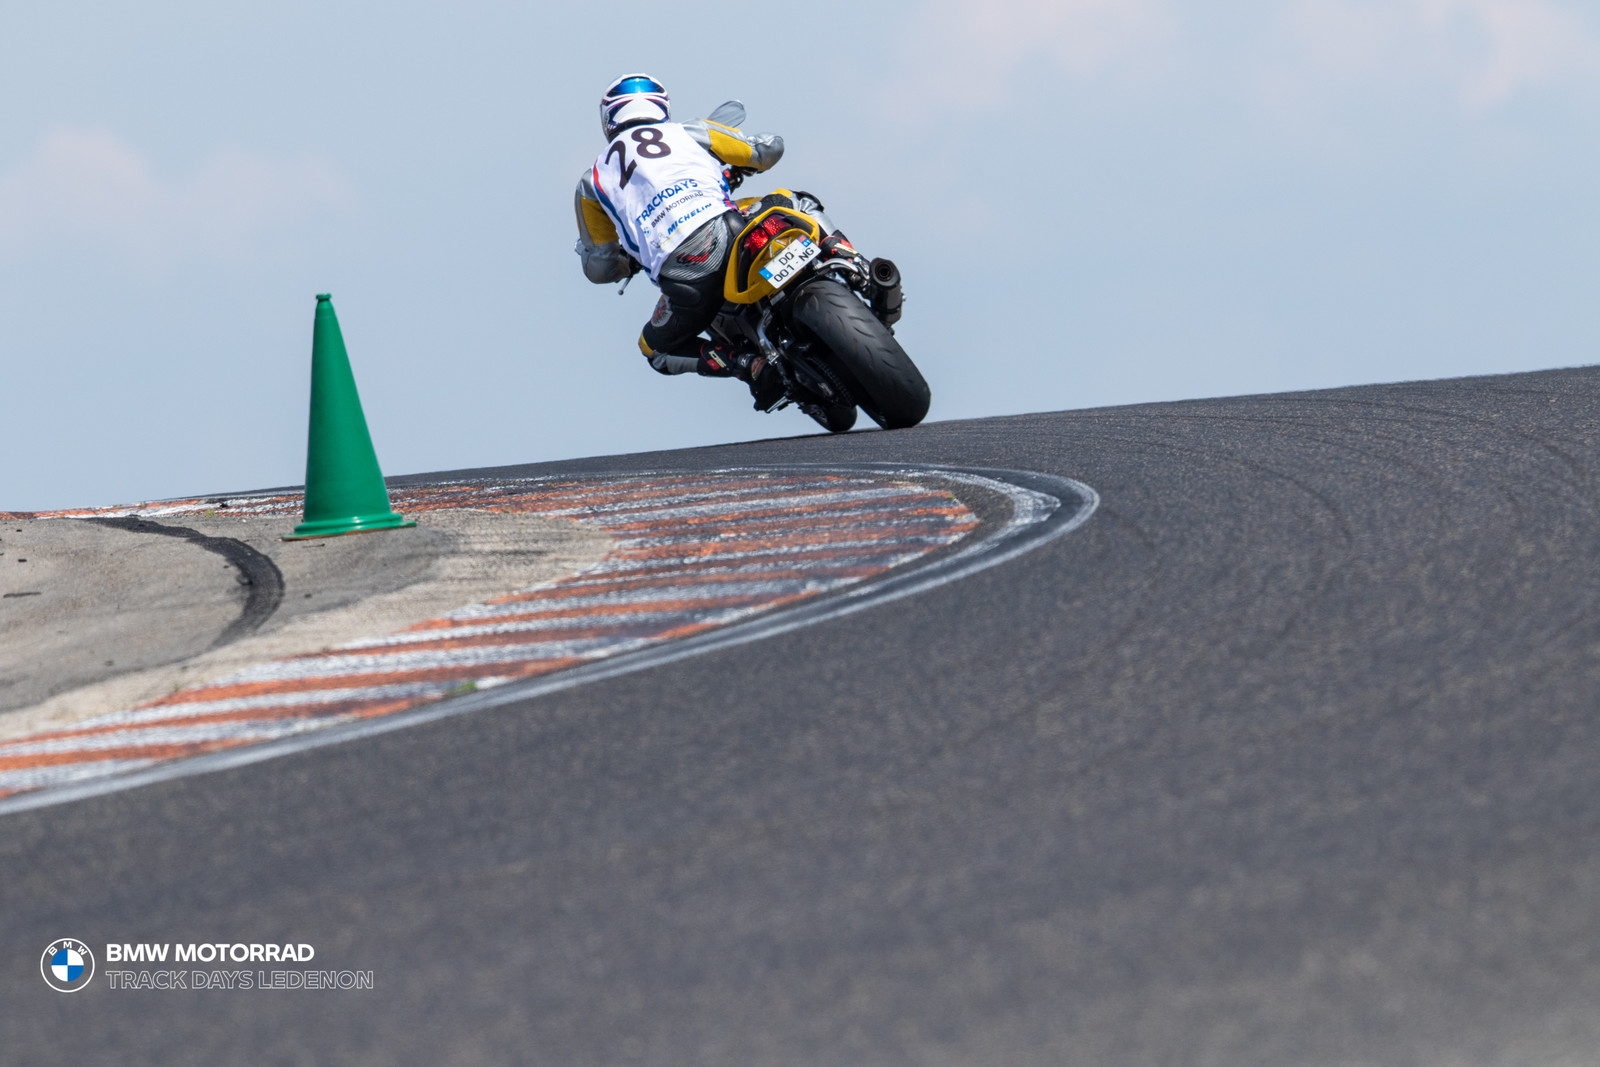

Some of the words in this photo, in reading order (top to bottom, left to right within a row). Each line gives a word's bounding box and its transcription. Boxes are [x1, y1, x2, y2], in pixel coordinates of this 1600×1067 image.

[605, 127, 672, 190] 28
[636, 179, 698, 225] TRACKDAYS
[651, 211, 666, 228] BMW
[665, 191, 704, 212] MOTORRAD
